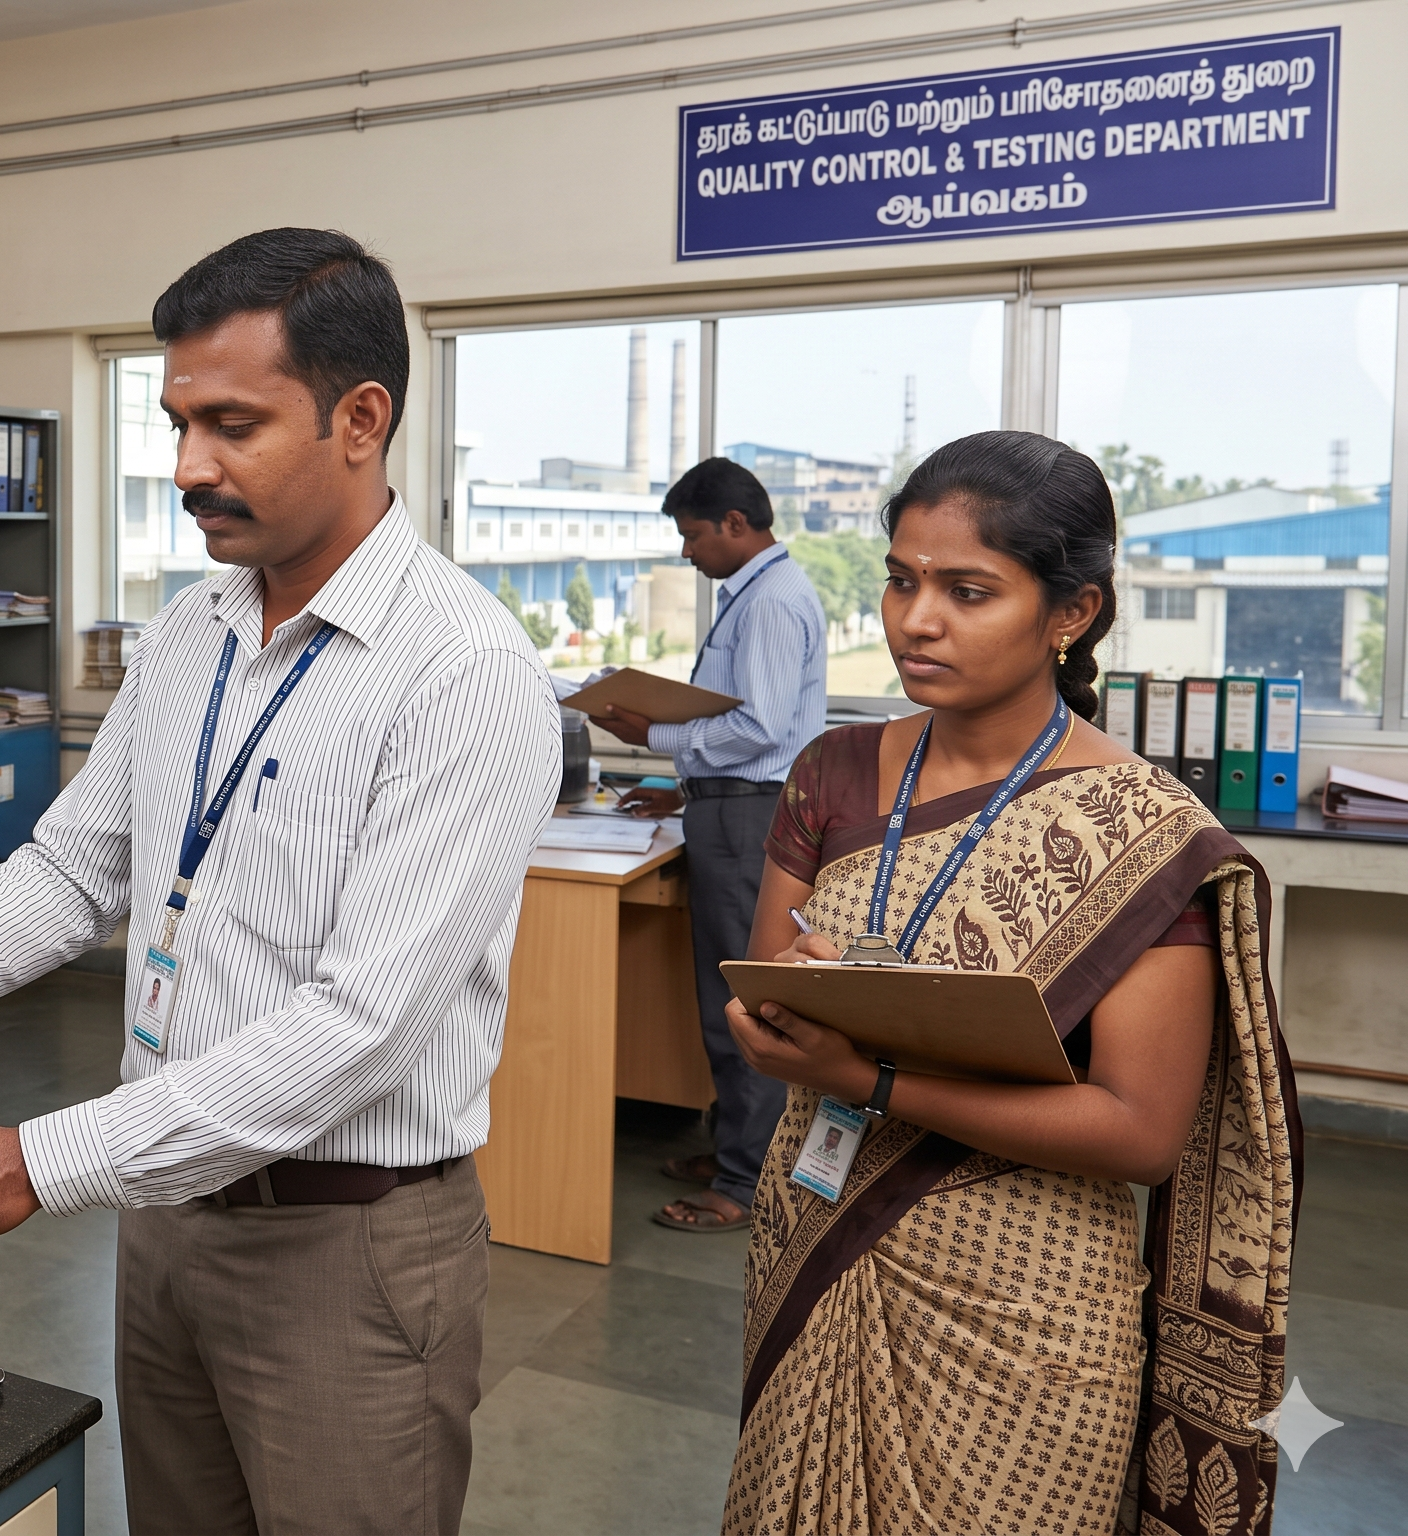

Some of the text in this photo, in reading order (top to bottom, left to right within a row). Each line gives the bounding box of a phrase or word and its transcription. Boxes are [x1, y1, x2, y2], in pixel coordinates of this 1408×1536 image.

[696, 56, 1316, 158] தரக் கட்டுப்பாடு மற்றும் பரிசோதனைத் துறை
[697, 105, 1312, 198] QUALITY CONTROL & TESTING DEPARTMENT
[876, 171, 1088, 229] ஆய்வகம்
